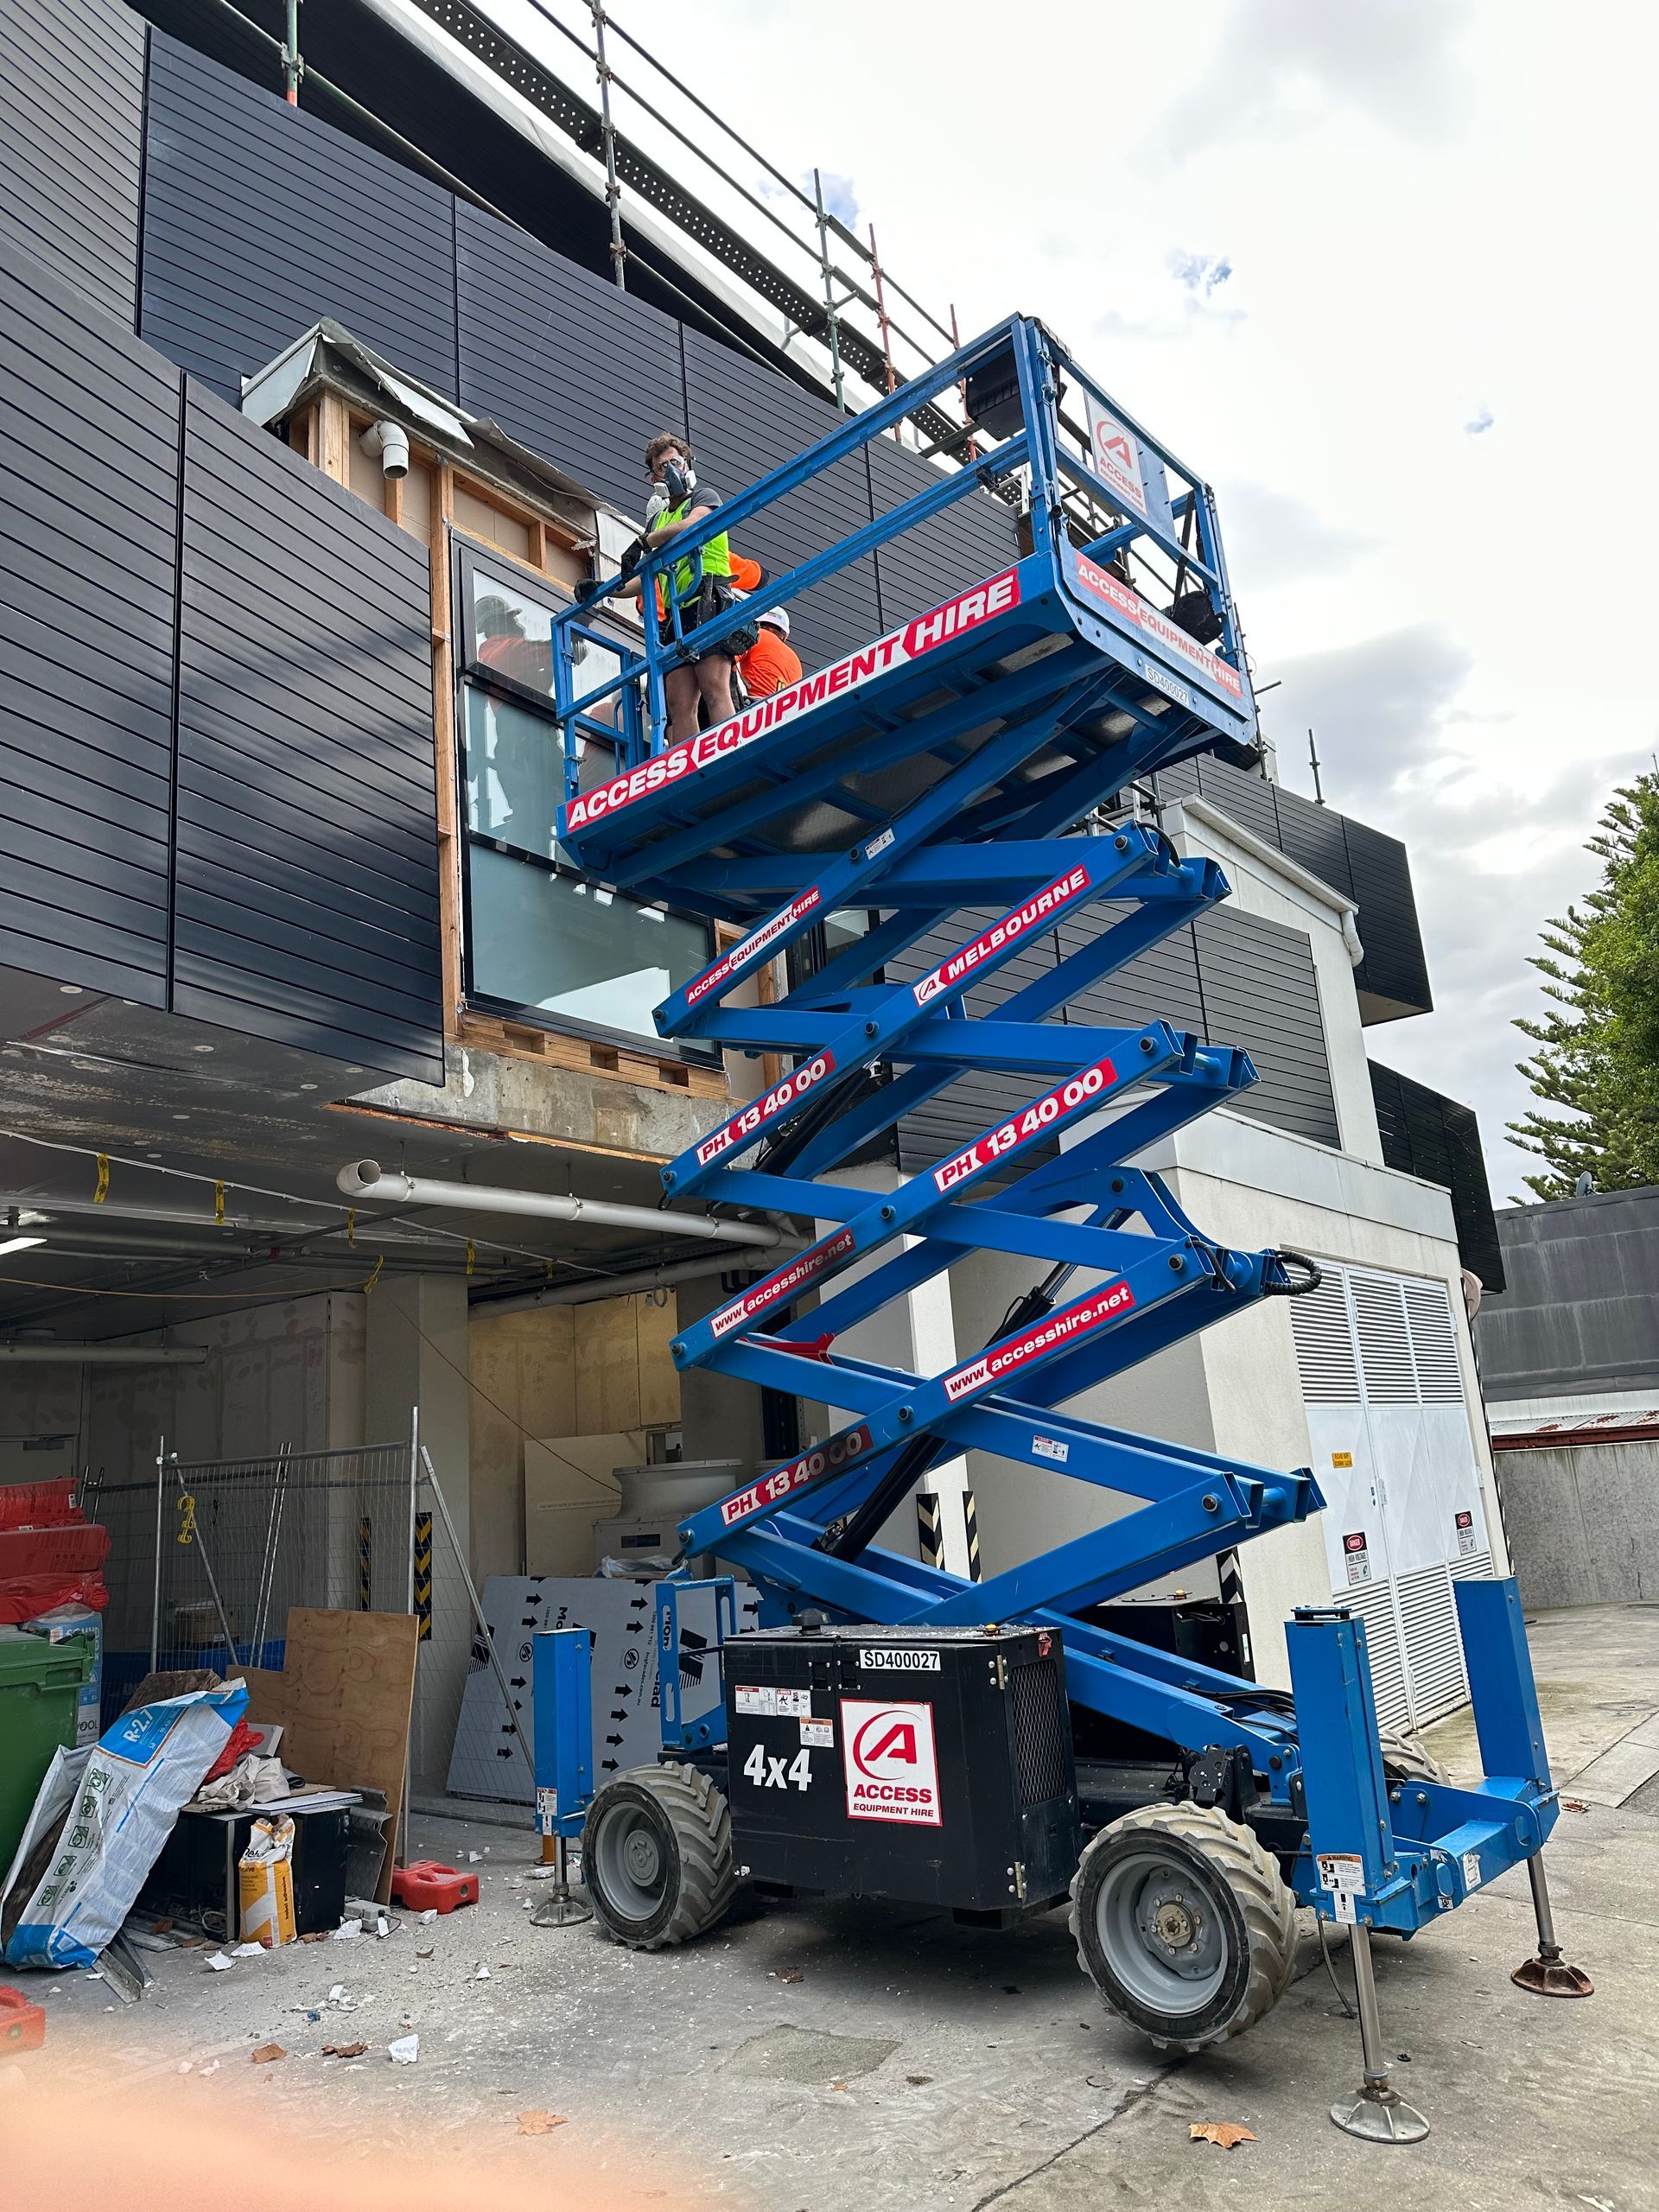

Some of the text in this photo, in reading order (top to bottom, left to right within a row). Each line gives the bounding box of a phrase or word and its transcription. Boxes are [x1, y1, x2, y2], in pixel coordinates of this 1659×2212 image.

[1100, 456, 1142, 499] ACCESS
[1078, 564, 1241, 688] ACCESS EQUIPMENT HIRE
[568, 574, 1014, 830] ACCESS EQUIPMENT HIRE
[1147, 667, 1189, 703] SD400027
[688, 890, 820, 1003] ACCESS EQUIPMENT HIRE
[948, 868, 1085, 980] MELBOURNE
[702, 1058, 826, 1164] PH 13 40 00
[943, 1068, 1103, 1190] PH 13 40 00
[714, 1234, 854, 1334] www accesshire.net
[950, 1287, 1130, 1394] www accesshire.net
[727, 1431, 862, 1521] PH 13 40 00
[865, 1651, 938, 1669] SD400027
[123, 1708, 154, 1744] R-2.7
[743, 1744, 813, 1792] 4x4
[853, 1783, 932, 1804] ACCESS
[853, 1802, 934, 1818] EQUIPMENT HIRE
